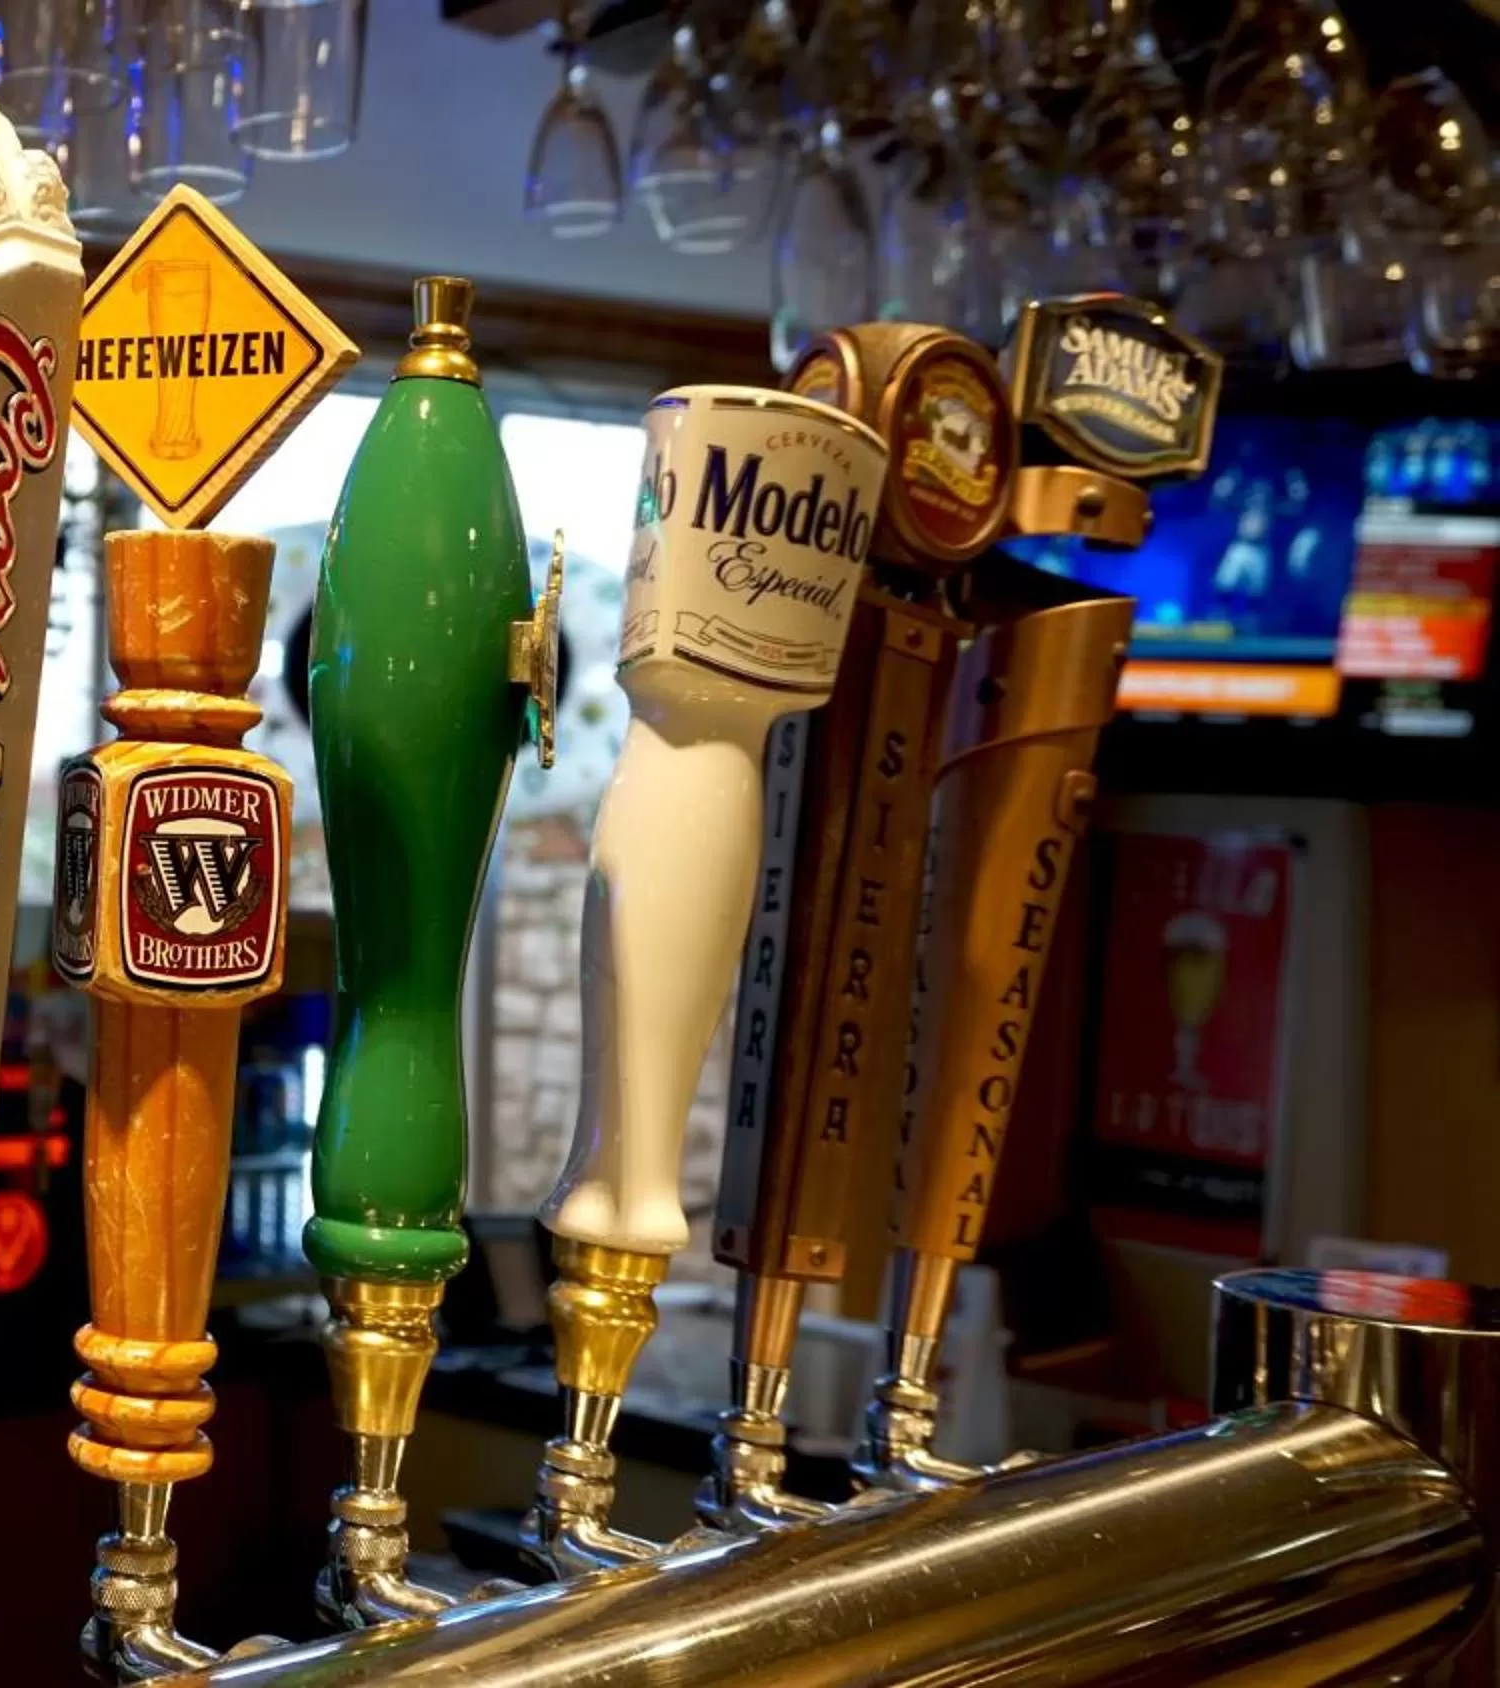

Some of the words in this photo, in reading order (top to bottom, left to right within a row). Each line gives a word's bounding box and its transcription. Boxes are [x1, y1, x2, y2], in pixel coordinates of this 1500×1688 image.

[75, 331, 286, 381] HEFEWEIZEN
[765, 430, 853, 476] CERVEZA
[691, 443, 871, 564] Modelo
[142, 786, 262, 824] WIDMER
[138, 833, 265, 922] W
[135, 931, 260, 971] BROTHERS
[737, 721, 798, 1129] SIERRA
[820, 731, 906, 1144] SIERRA
[954, 838, 1062, 1248] SEASONAL
